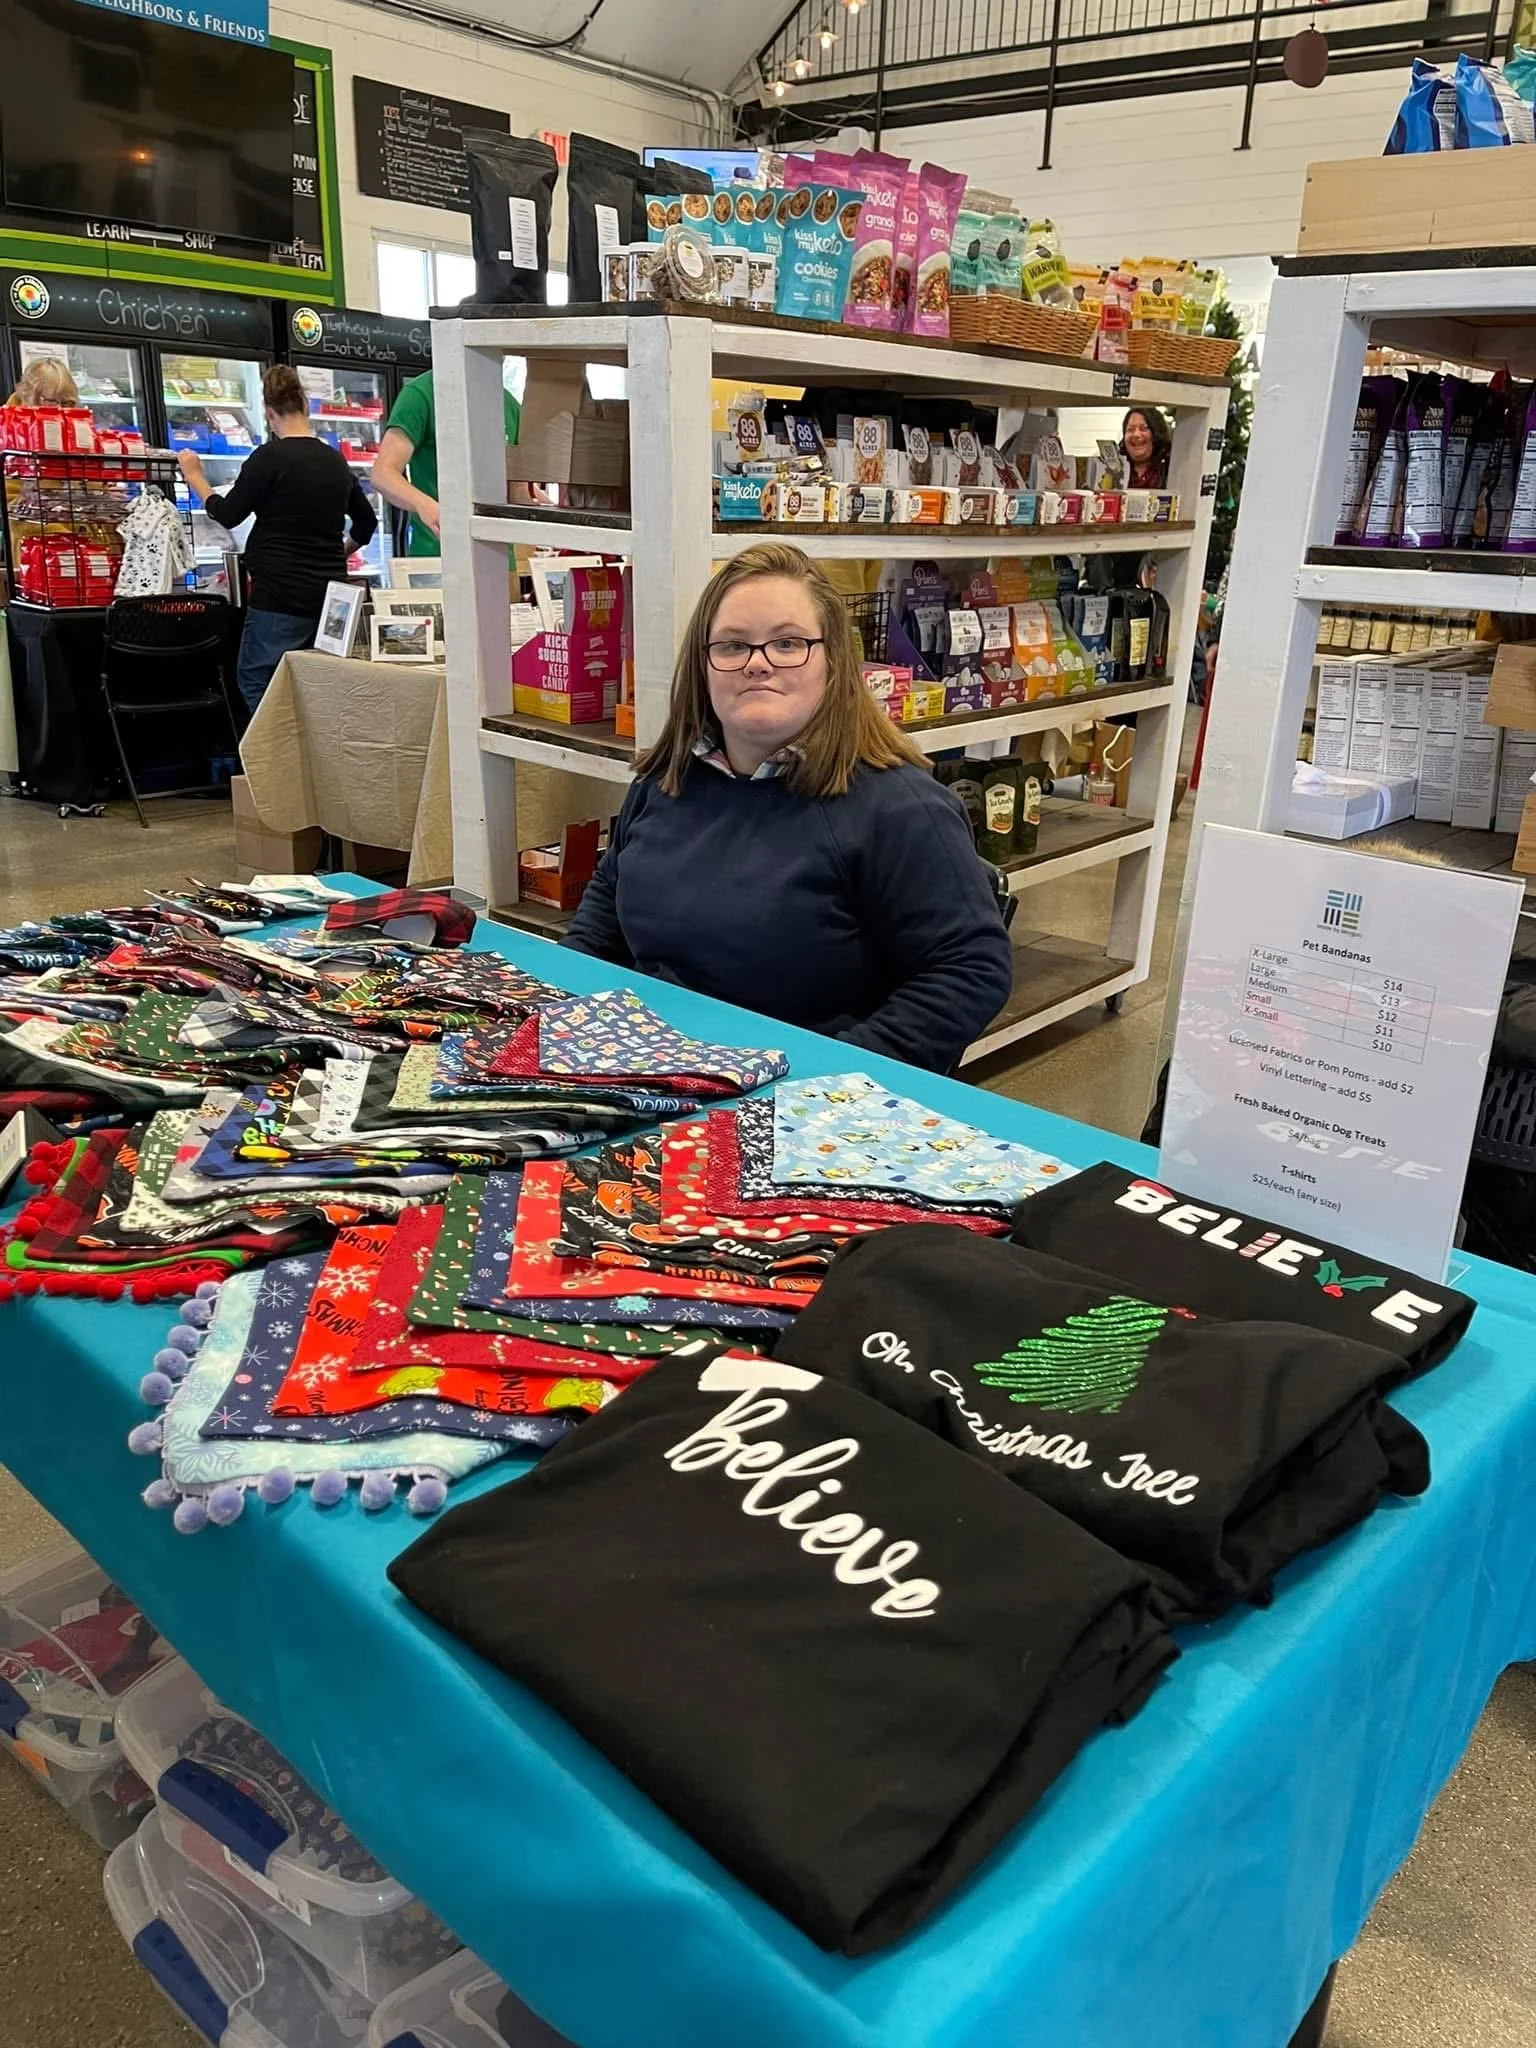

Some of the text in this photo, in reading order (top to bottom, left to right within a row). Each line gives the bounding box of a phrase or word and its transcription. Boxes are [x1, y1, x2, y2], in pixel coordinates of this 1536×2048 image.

[97, 0, 265, 42] EIGHBORS & FRIENDS
[86, 222, 216, 250] LEARN SHOP
[794, 261, 839, 280] cookies
[97, 288, 210, 336] Chicken
[320, 313, 370, 344] Turkey
[322, 335, 366, 357] Exotic
[740, 418, 757, 438] 88
[796, 424, 813, 442] 88
[863, 426, 877, 444] 88
[736, 481, 762, 500] keto
[538, 647, 569, 664] SUGAR
[545, 634, 569, 650] KICK
[542, 675, 569, 692] CANDY
[549, 663, 569, 678] KEEP
[1303, 940, 1371, 964] Pet Bandanas
[1250, 963, 1400, 1007] Large $13
[1252, 949, 1403, 992] X-Large $14
[1246, 991, 1393, 1037] Small $11
[1248, 977, 1397, 1022] Medium $12
[1243, 1005, 1392, 1052] X-Small $10
[1229, 1035, 1268, 1053] Licensed
[1270, 1046, 1303, 1064] Fabrics
[1305, 1058, 1316, 1067] or
[1318, 1060, 1340, 1073] Pom
[1342, 1066, 1370, 1082] Poms
[1378, 1078, 1398, 1090] add
[1400, 1083, 1415, 1096] $2
[1260, 1062, 1283, 1077] Vinyl
[1284, 1069, 1328, 1091] Lettering
[1337, 1087, 1357, 1098] add
[1359, 1091, 1372, 1103] $5
[1234, 1093, 1386, 1148] Fresh Baked Organic Dog Treats
[1287, 1128, 1321, 1149] $4/bag
[1281, 1164, 1317, 1184] T-shirts
[1252, 1173, 1342, 1213] $25/each (any size)
[862, 1331, 915, 1374] Oh
[929, 1368, 1093, 1470] Christmas
[1102, 1453, 1200, 1506] Tree
